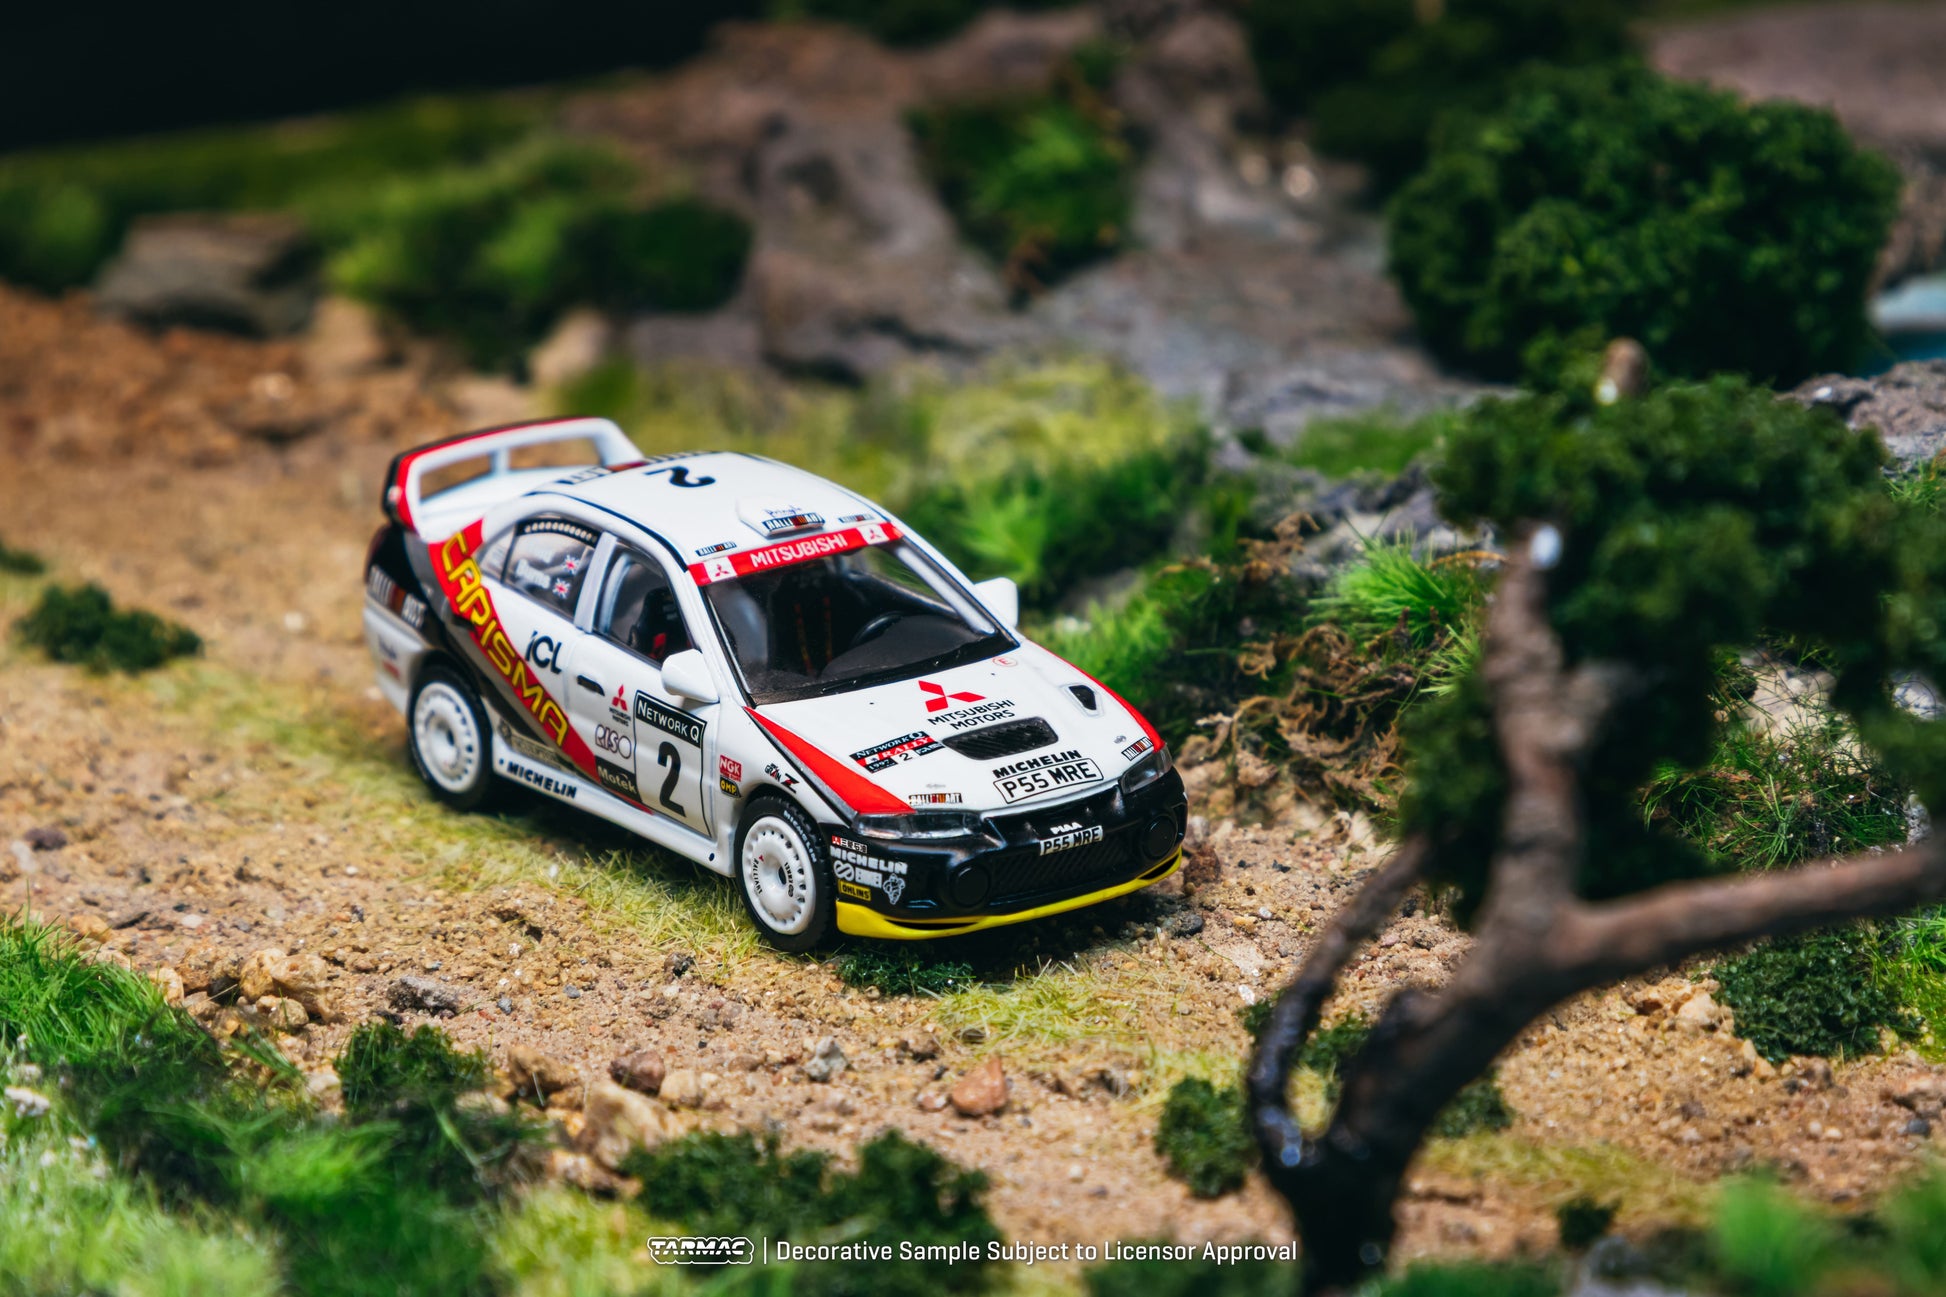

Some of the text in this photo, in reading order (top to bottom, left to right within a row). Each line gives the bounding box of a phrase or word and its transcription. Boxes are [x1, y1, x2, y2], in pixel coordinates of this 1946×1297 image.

[641, 465, 716, 488] 2
[749, 533, 848, 568] MITSUBISHI
[441, 531, 569, 748] CARISMA
[927, 699, 1016, 726] MITSUBISHI
[949, 709, 1015, 731] MOTORS
[594, 723, 632, 760] RISO
[689, 725, 700, 743] Q
[908, 730, 923, 742] Q
[881, 737, 930, 758] RALLY
[899, 752, 913, 762] 2
[719, 757, 740, 776] NGK
[868, 759, 890, 771] 1997
[992, 749, 1082, 779] MICHELIN
[506, 761, 578, 799] MICHELIN
[657, 740, 687, 818] 2
[720, 779, 737, 794] OMP
[1001, 761, 1097, 799] P55 MRE
[1043, 827, 1102, 854] P55 MRE
[1049, 821, 1084, 836] PIAA
[829, 844, 908, 875] MICHELIN
